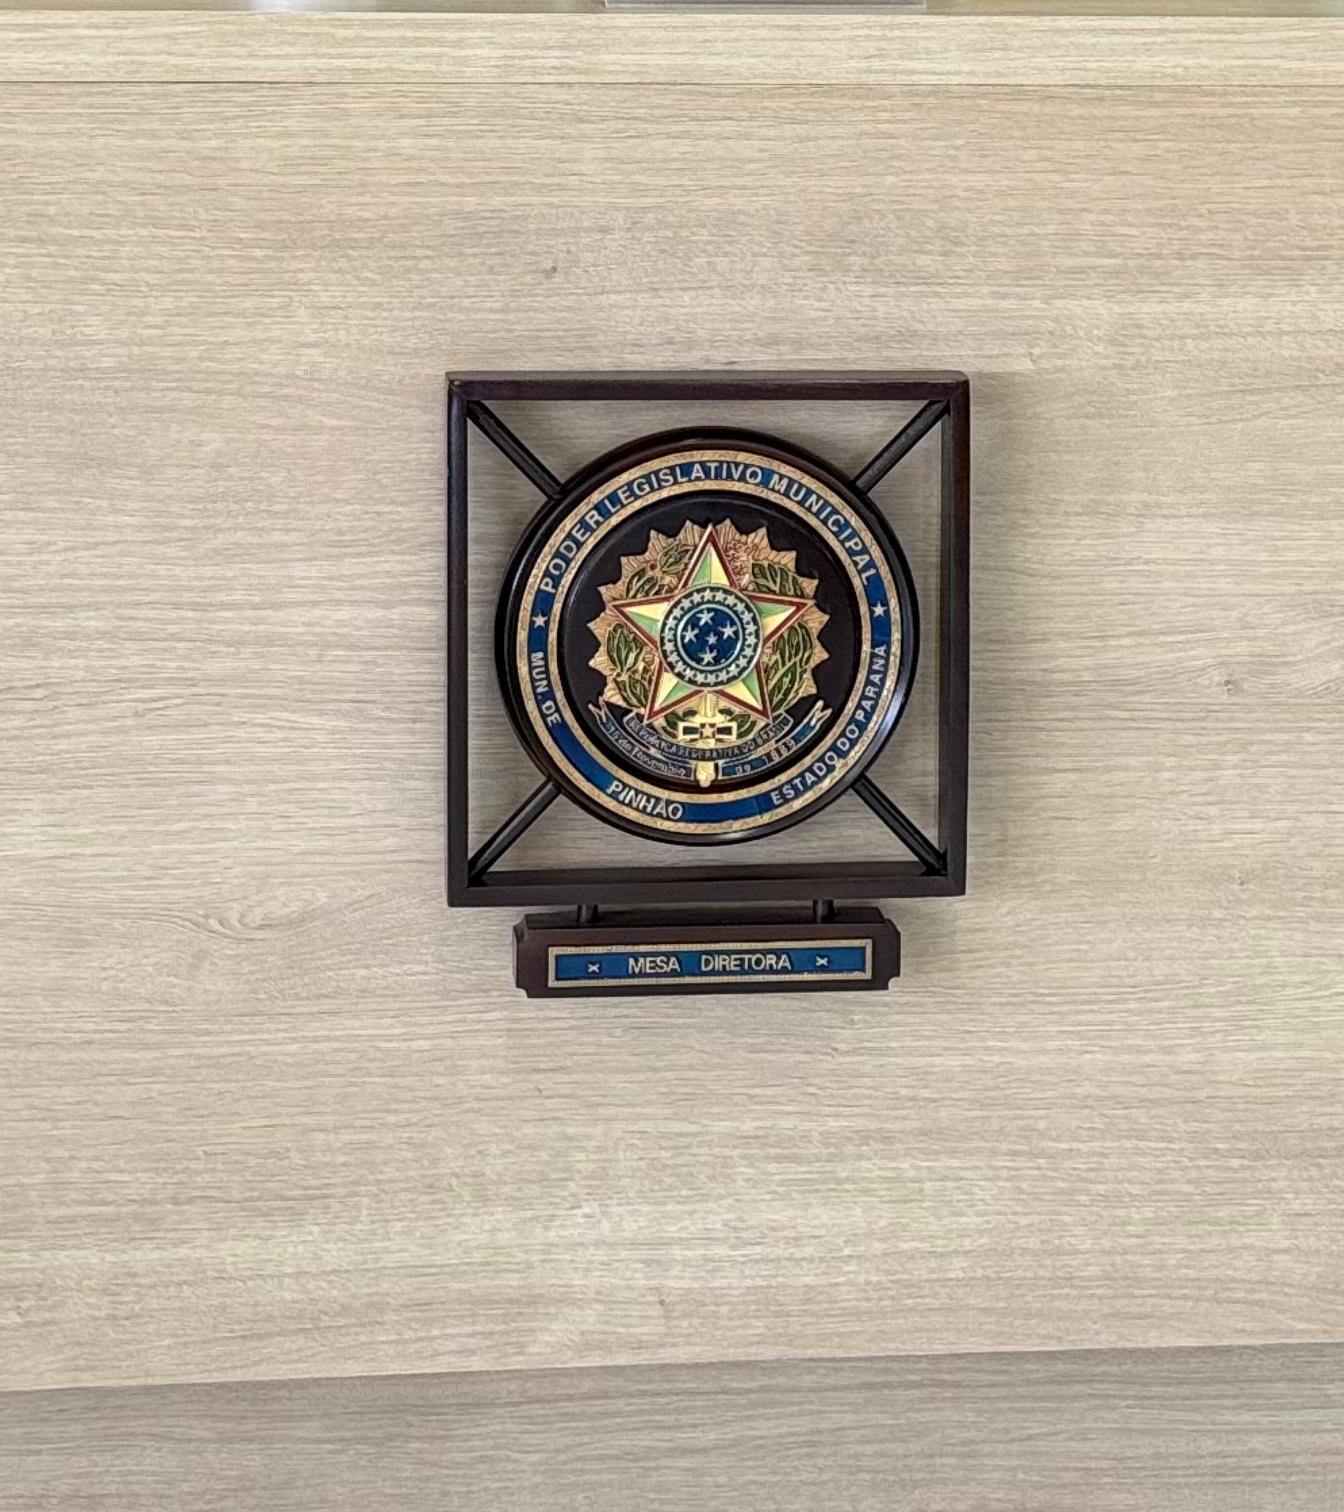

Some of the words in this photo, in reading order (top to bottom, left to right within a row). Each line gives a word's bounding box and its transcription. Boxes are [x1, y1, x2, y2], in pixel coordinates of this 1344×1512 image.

[539, 509, 605, 594] PODER
[604, 462, 762, 516] LEGISLATIVO
[768, 472, 878, 586] MUNICIPAL
[541, 701, 562, 727] DE
[770, 751, 838, 805] ESTADO
[837, 723, 859, 752] DO
[627, 955, 681, 975] MESA
[700, 953, 792, 972] DIRETORA
